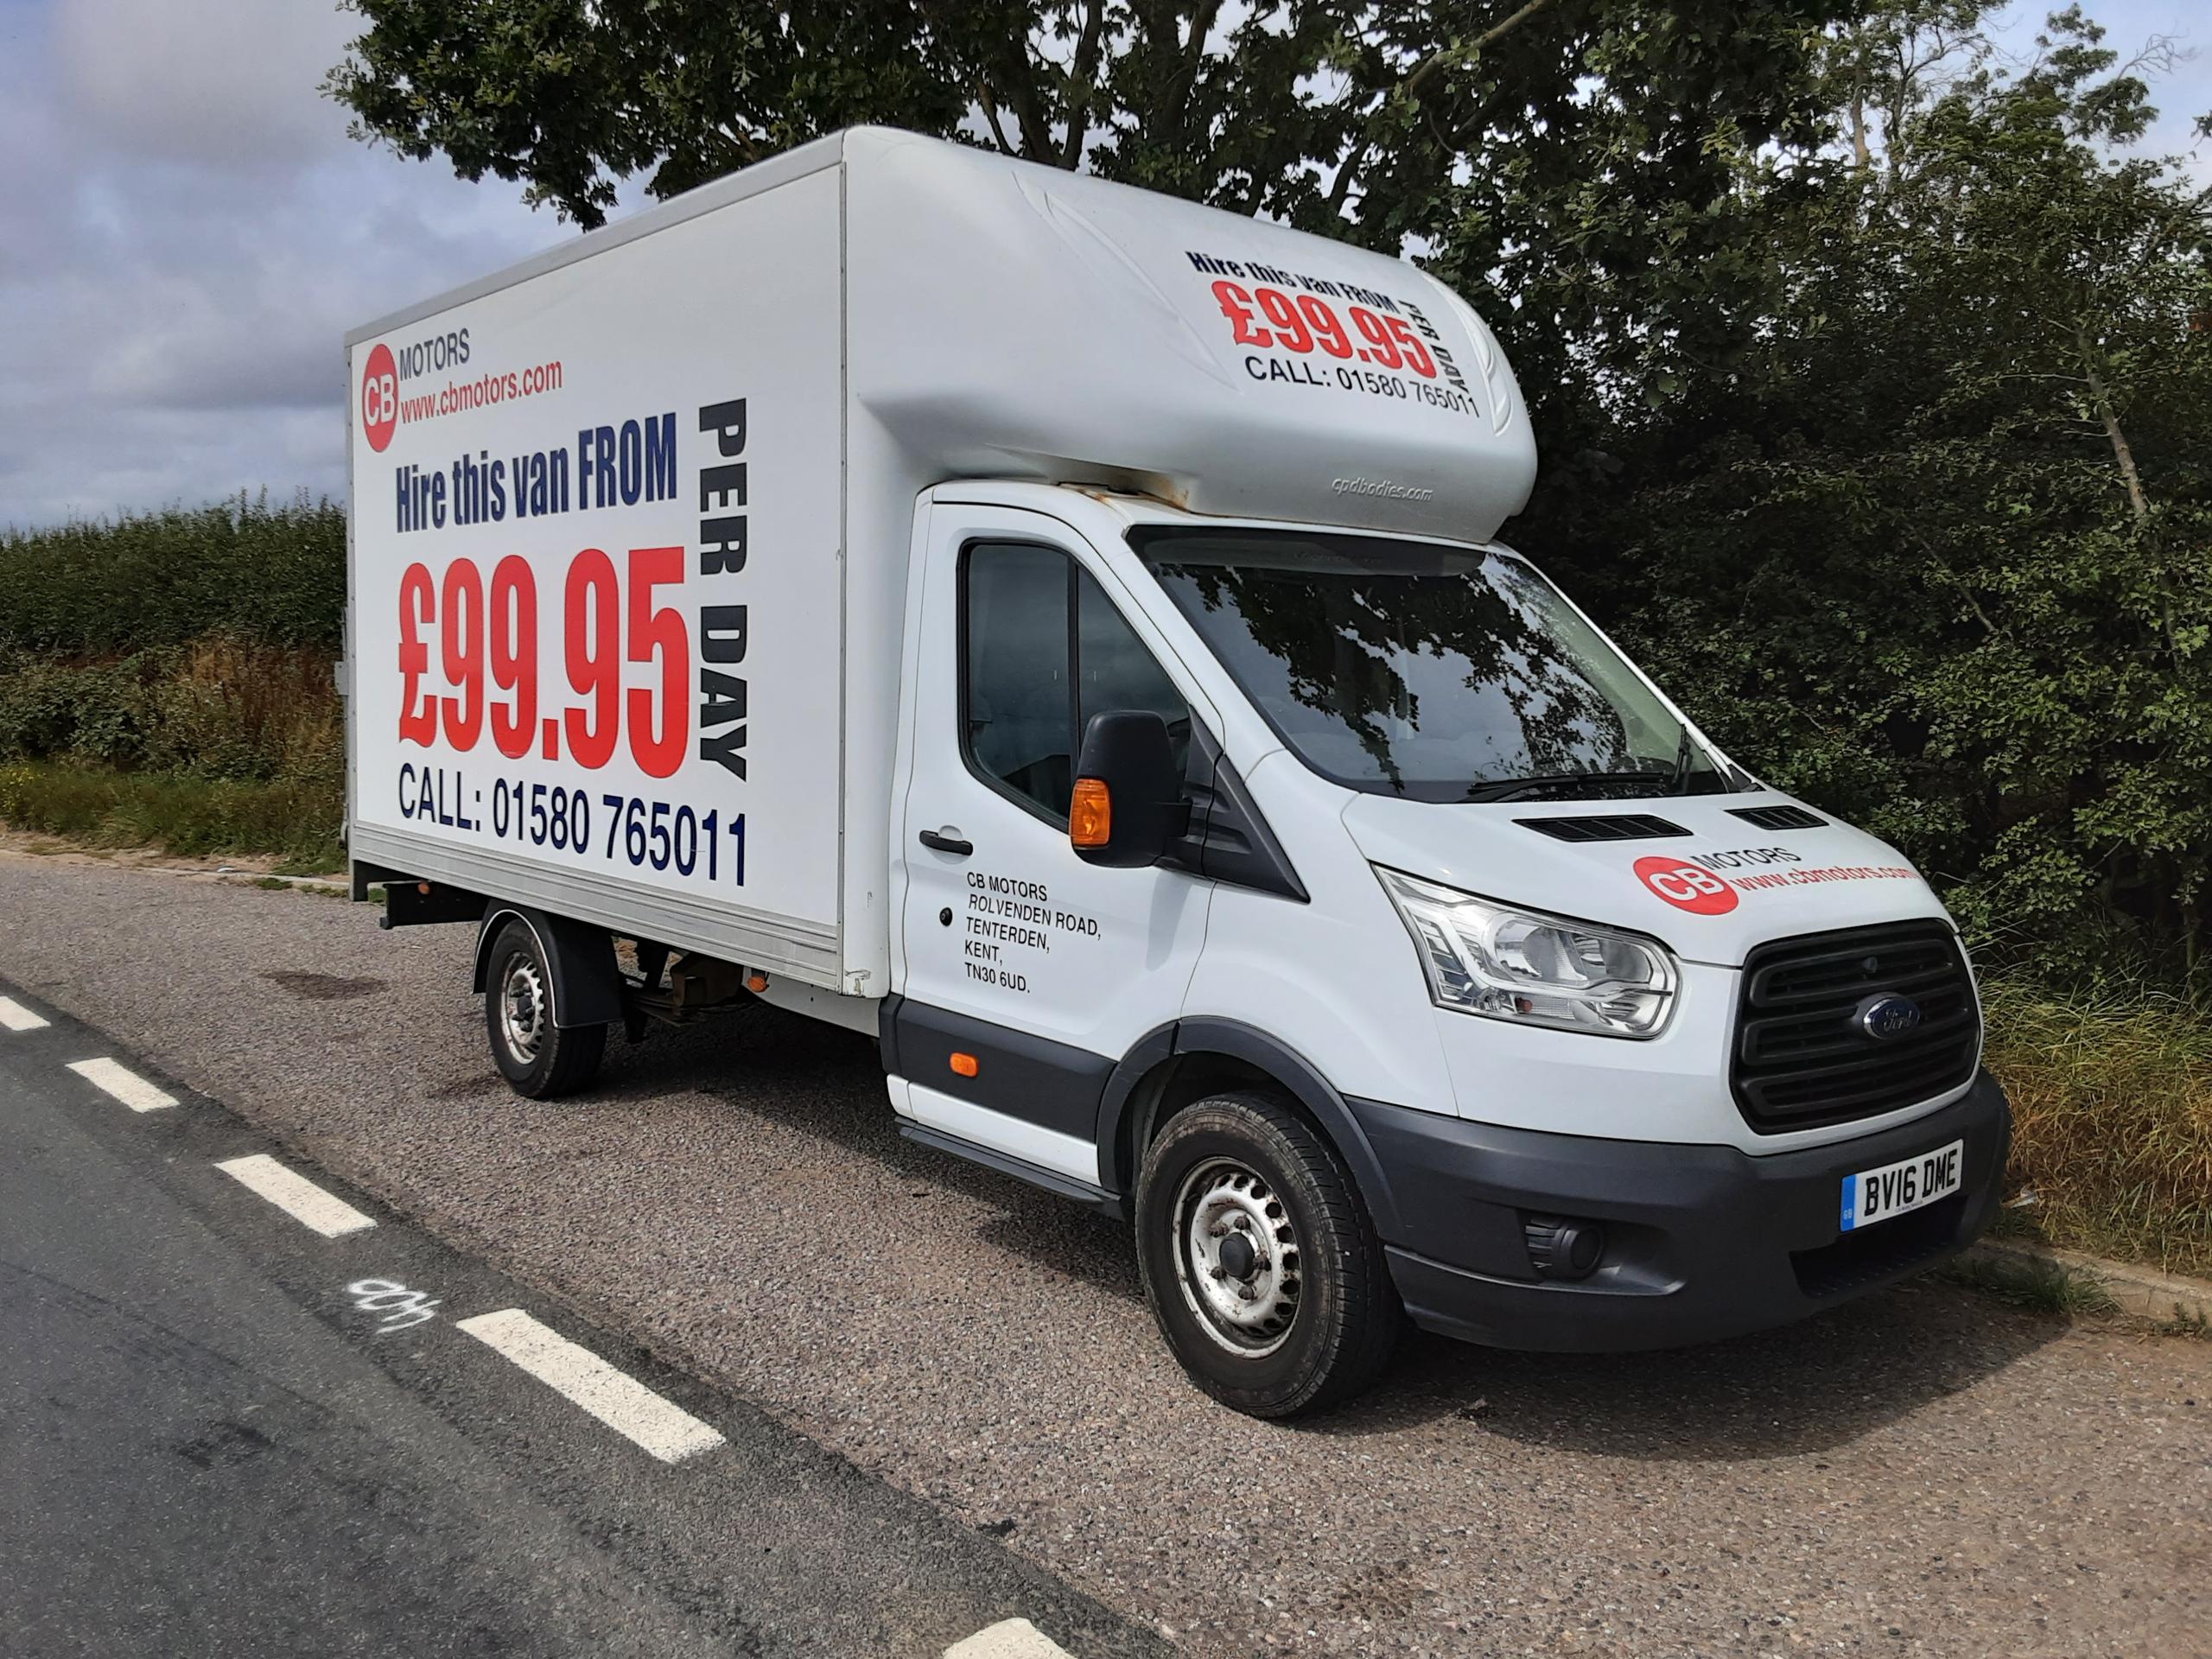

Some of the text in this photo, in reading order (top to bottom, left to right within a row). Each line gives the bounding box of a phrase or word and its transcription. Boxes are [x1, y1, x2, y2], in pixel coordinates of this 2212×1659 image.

[1185, 251, 1401, 315] Hire this van FROM
[399, 327, 470, 381] MOTORS
[1211, 281, 1438, 378] £99.95
[1397, 300, 1470, 394] PER DAY
[363, 372, 395, 427] CB
[401, 360, 563, 423] www.cbmotors.com
[1244, 356, 1481, 418] CALL: 01580 765011
[396, 412, 677, 533] Hire this van FROM
[1332, 477, 1433, 501] cpdbodies.com
[698, 397, 747, 783] PER DAY
[398, 546, 690, 779] £99.95
[398, 763, 746, 887] CALL: 01580 765011
[967, 872, 1048, 901] CB MOTORS
[1649, 868, 1726, 901] CB
[1690, 848, 1802, 871] MOTORS
[1730, 866, 1920, 892] www.cbmotors.com
[966, 916, 1050, 953] TENTERDEN,
[968, 893, 1102, 940] ROLVENDEN ROAD,
[964, 939, 1003, 966] KENT,
[964, 962, 1031, 993] TN30 6UD.
[1884, 1007, 1913, 1033] Ford
[1864, 1148, 1958, 1217] BV16 DME
